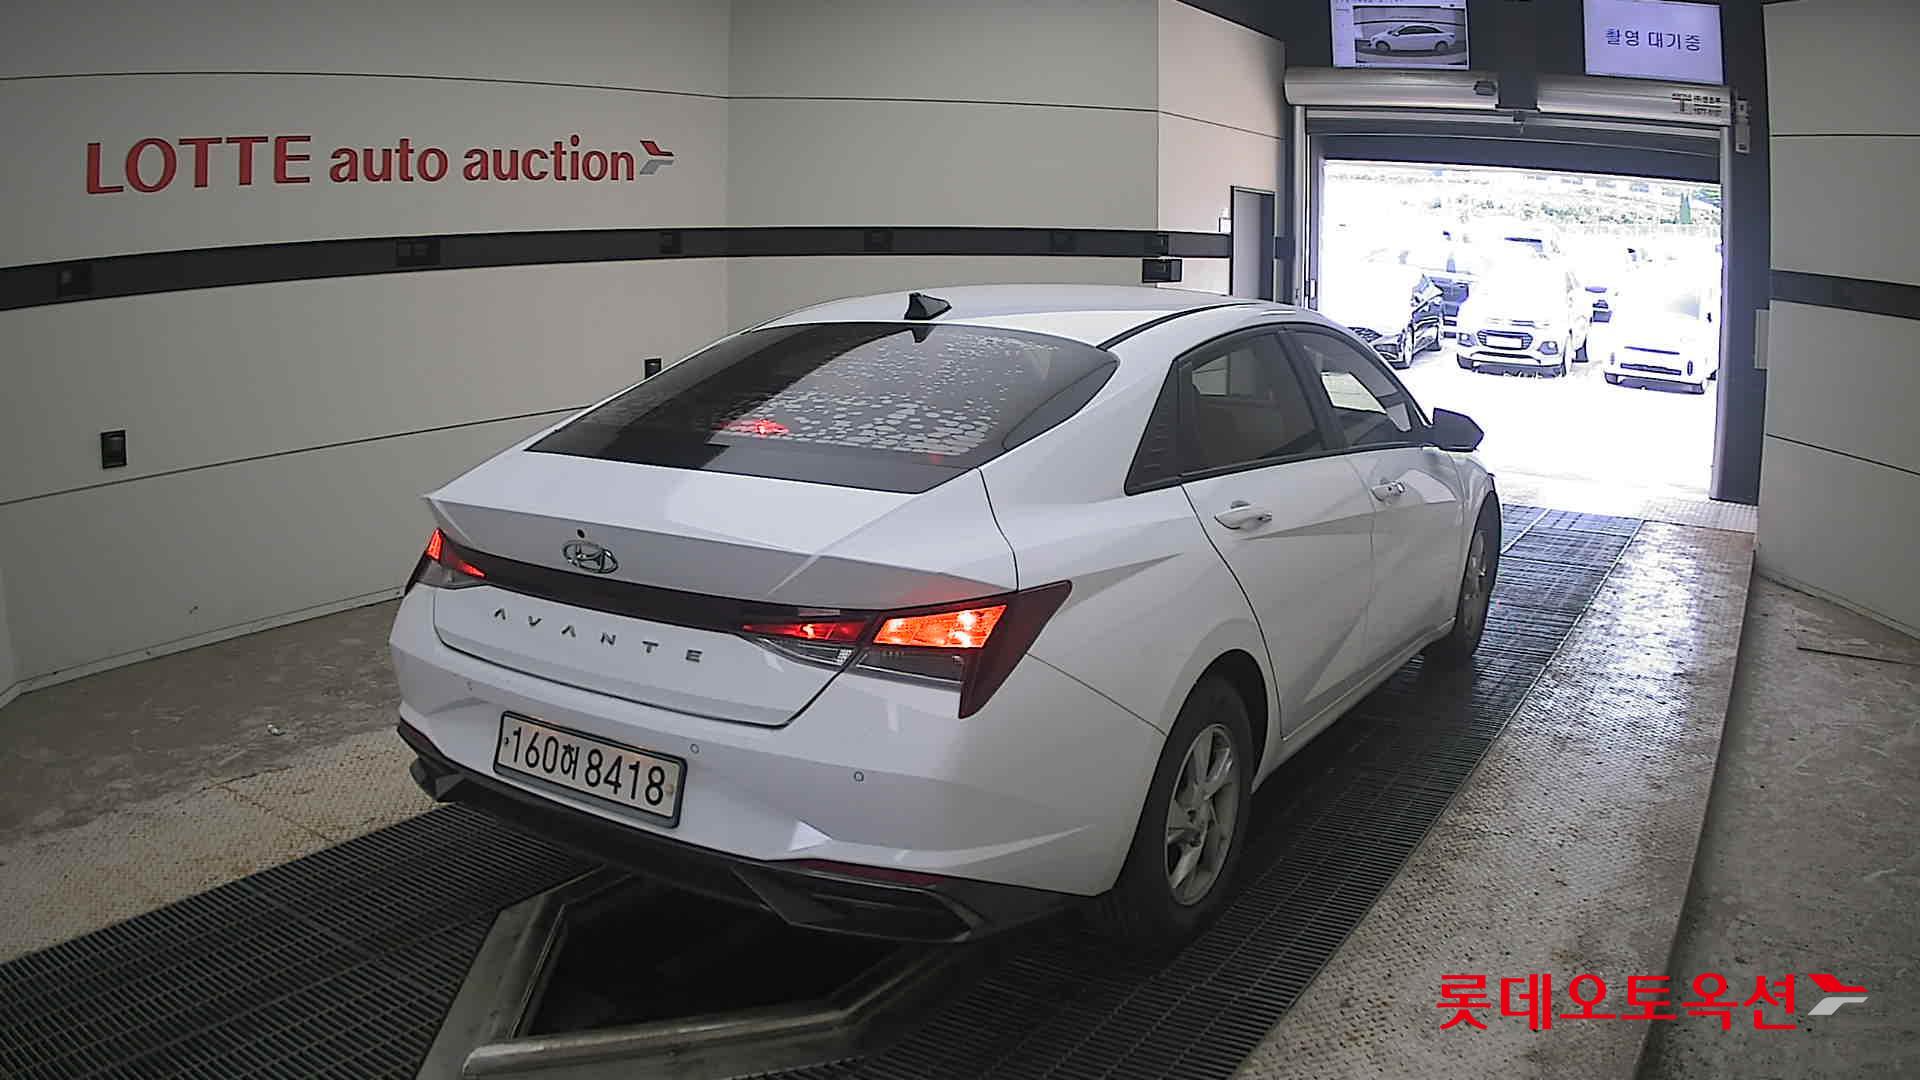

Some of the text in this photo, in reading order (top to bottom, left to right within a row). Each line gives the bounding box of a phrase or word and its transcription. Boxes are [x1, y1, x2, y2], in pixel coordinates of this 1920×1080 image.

[1606, 28, 1640, 47] 촬영
[86, 134, 636, 194] LOTTE auto auction
[493, 607, 704, 663] AVANTE
[512, 726, 666, 806] 160허8418
